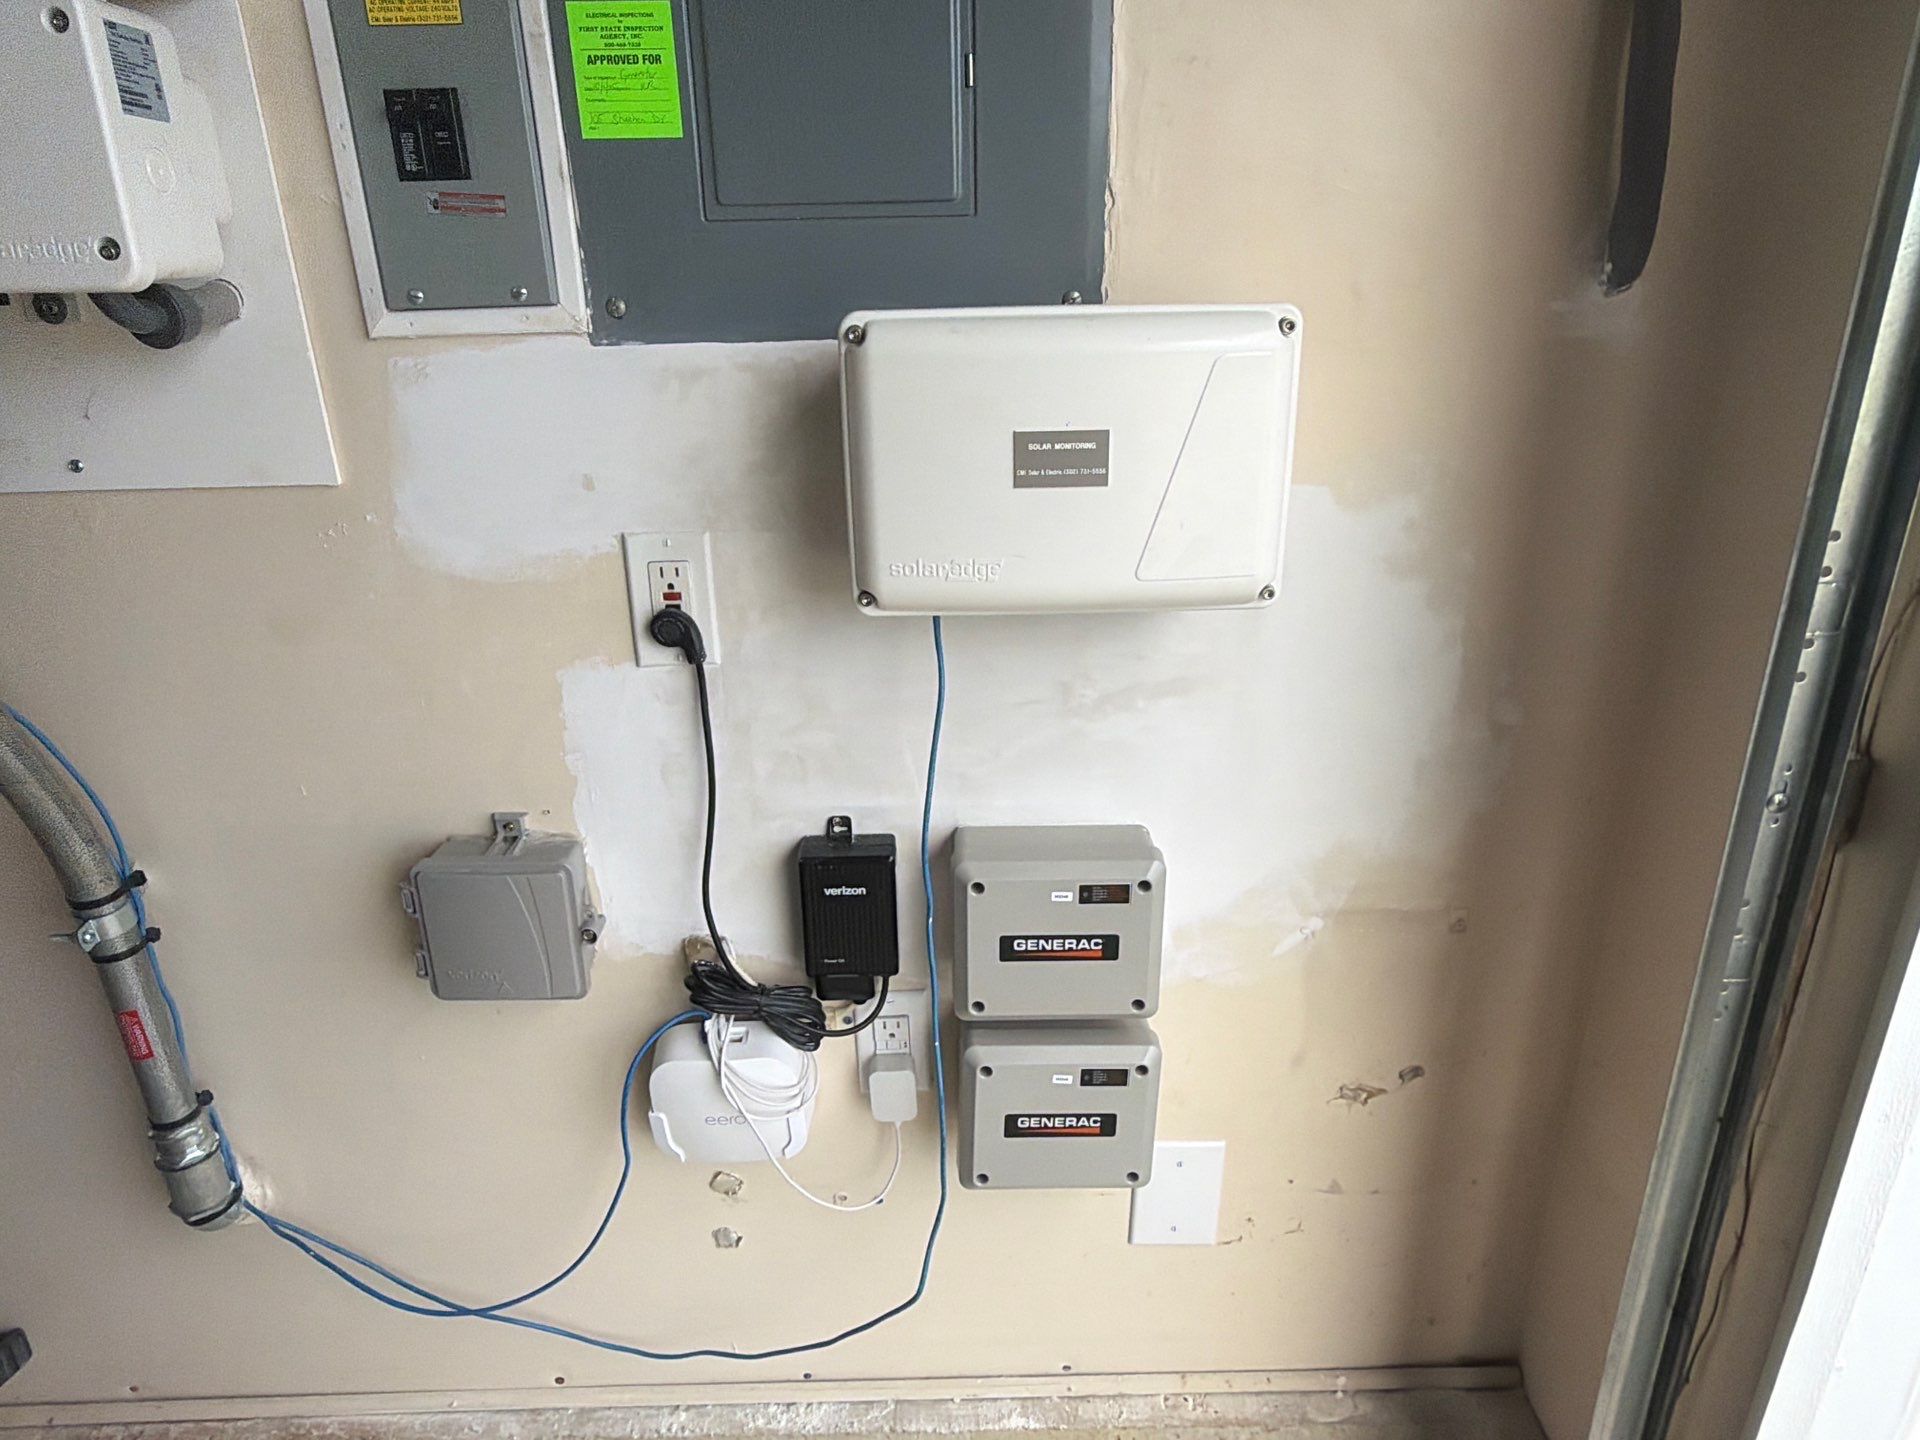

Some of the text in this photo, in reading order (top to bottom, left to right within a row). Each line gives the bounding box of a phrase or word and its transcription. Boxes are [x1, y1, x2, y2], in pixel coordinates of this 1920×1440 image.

[587, 54, 662, 65] APPROVED FOR
[1054, 442, 1097, 450] MONITORING
[824, 886, 866, 896] verizon
[1013, 939, 1103, 951] GENERAC
[705, 1115, 747, 1126] eero
[1017, 1117, 1101, 1128] GENERAC
